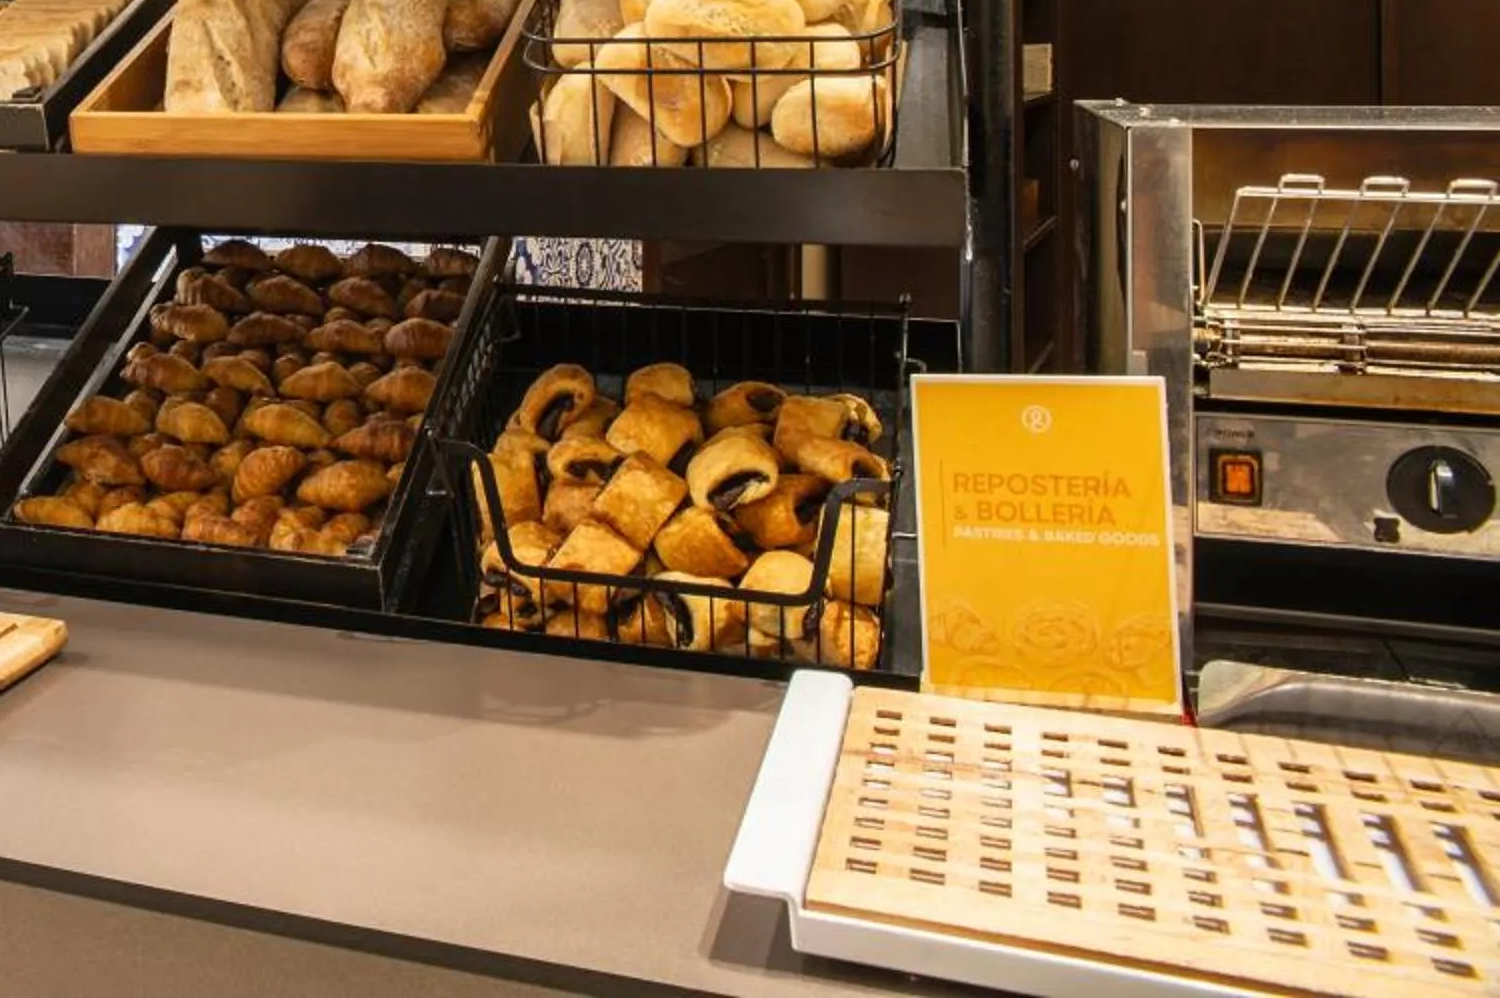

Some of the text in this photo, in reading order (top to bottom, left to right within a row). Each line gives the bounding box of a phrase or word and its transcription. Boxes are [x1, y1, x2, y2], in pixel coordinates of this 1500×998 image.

[953, 470, 1132, 499] REPOSTERÍA
[954, 498, 1116, 526] & BOLLERÍA
